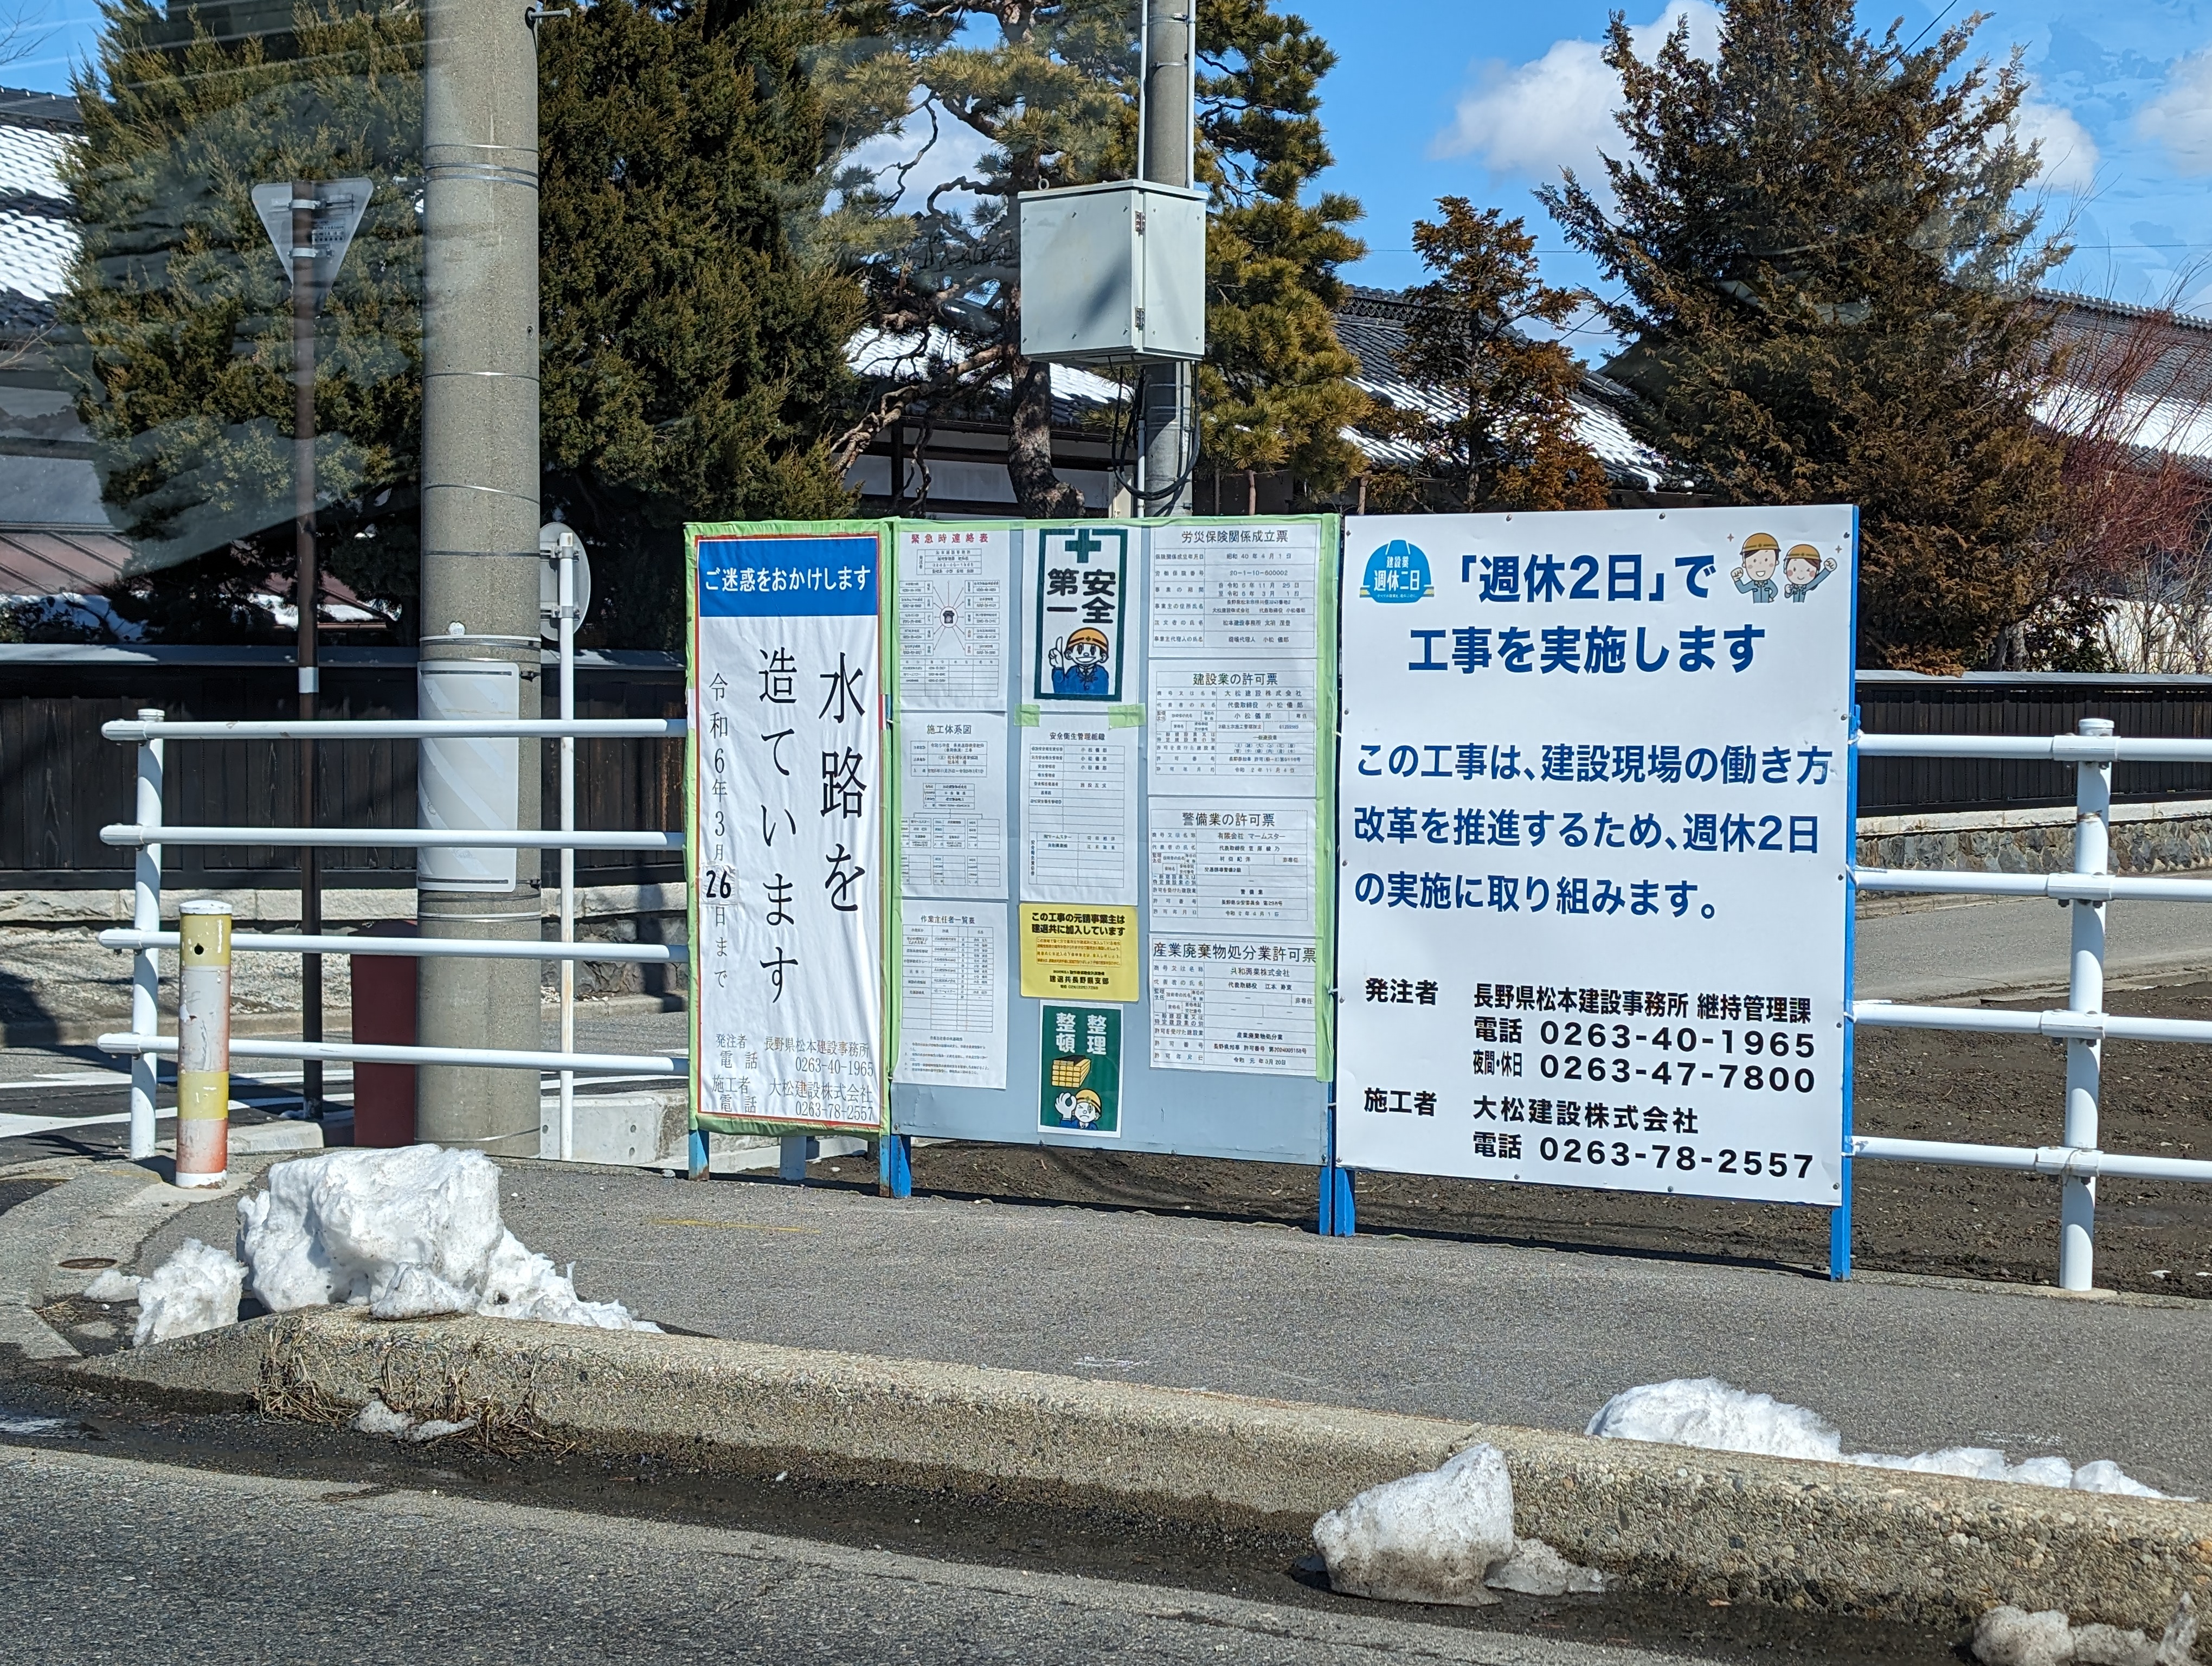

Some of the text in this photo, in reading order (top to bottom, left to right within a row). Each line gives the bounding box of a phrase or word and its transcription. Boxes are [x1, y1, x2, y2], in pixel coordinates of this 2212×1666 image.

[1181, 530, 1288, 543] 労災保険関係成立票
[1386, 556, 1409, 568] 建設業
[705, 565, 871, 592] ご迷惑をおかけします
[1046, 568, 1079, 612] 第一
[1374, 570, 1420, 591] 週休二日
[1461, 553, 1716, 603] 「週休2日」で
[1082, 569, 1116, 624] 安全
[1409, 623, 1765, 675] 工事を実施します
[1193, 672, 1278, 685] 建設業の許可票
[927, 724, 972, 734] 施工体系図
[1357, 742, 1832, 786] この工事は、建設現場の働き方
[819, 652, 867, 911] 水路を
[705, 672, 731, 988] 令和6年3月26日まで
[759, 647, 799, 1003] 造ています
[1182, 812, 1275, 826] 警備業の許可票
[1354, 805, 1819, 854] 改革を推進するため、週休2日
[1355, 870, 1715, 920] の実施に取り組みます。
[1031, 924, 1126, 936] 建退共に加入しています
[1032, 912, 1126, 924] この工事の元請事業主は
[1153, 942, 1316, 963] 産業廃棄物処分業許可票
[1365, 978, 1439, 1005] 発注者
[1474, 983, 1688, 1020] 長野県松本建設事務所
[715, 1034, 748, 1049] 発注者
[1056, 1012, 1076, 1054] 整頓
[1087, 1014, 1107, 1055] 整理
[1474, 1016, 1815, 1059] 電話 0263-40-1965
[719, 1050, 758, 1070] 電話
[764, 1036, 869, 1058] 長野県松本建設事務所
[795, 1056, 873, 1077] 0263-40-1965
[1472, 1050, 1815, 1093] 夜間・休日 0263-47-7800
[711, 1075, 751, 1095] 施工者
[769, 1078, 873, 1103] 大松建設株式会社
[719, 1096, 757, 1113] 電話
[795, 1103, 873, 1122] 0263-78-2557
[1364, 1088, 1437, 1117] 施工者
[1472, 1095, 1698, 1134] 大松建設株式会社
[1472, 1131, 1814, 1179] 電話 0263-78-2557
